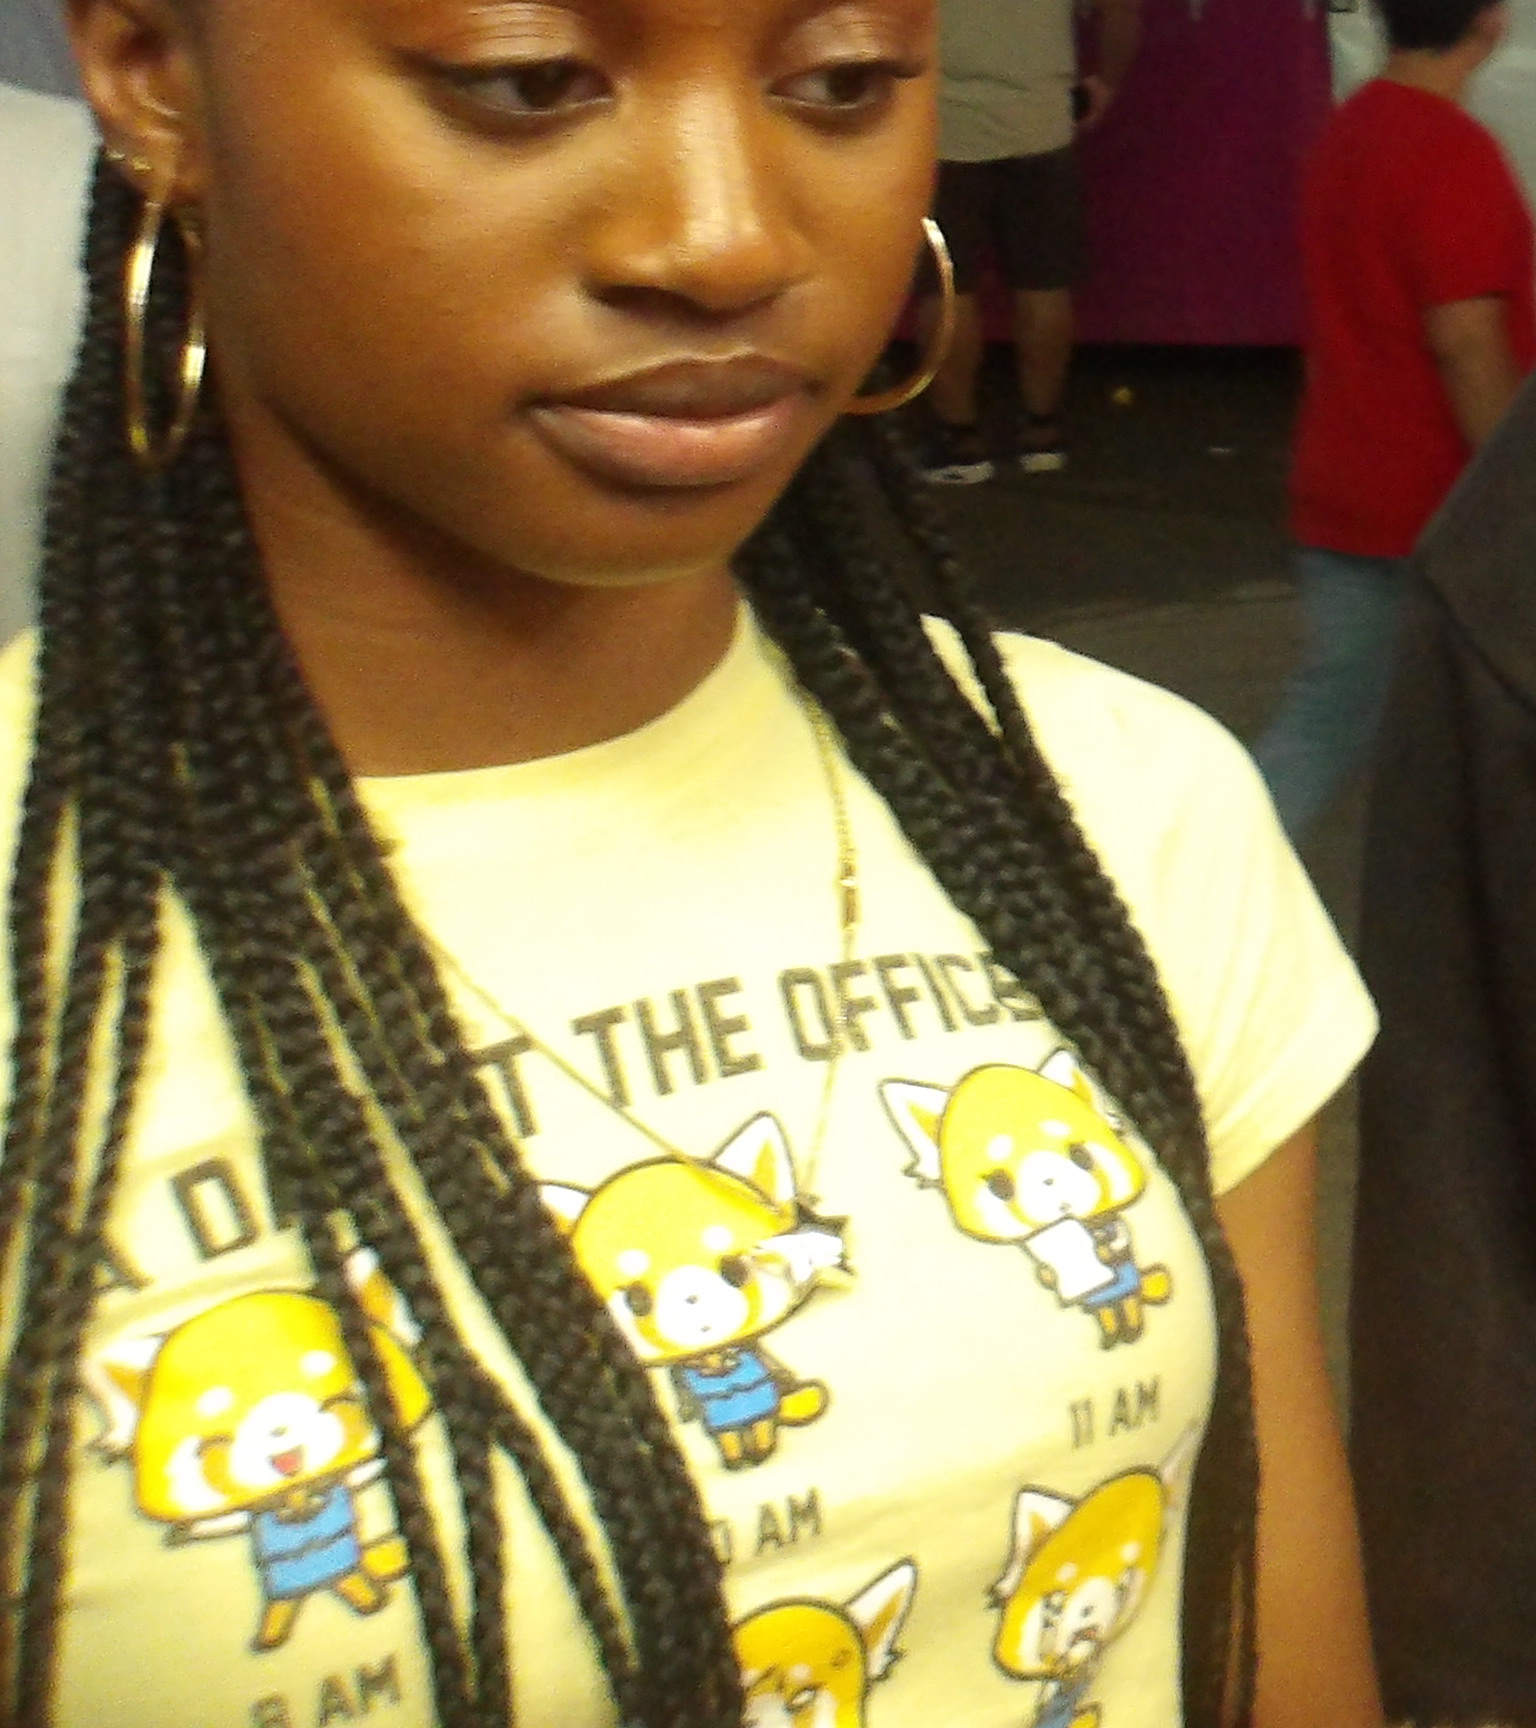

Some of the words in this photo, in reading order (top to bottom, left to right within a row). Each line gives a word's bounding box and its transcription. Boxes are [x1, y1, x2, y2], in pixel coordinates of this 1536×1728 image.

[571, 977, 764, 1108] THE
[777, 951, 1046, 1063] OFFICE
[1107, 1374, 1161, 1437] AM
[756, 1486, 822, 1556] AM
[318, 1651, 401, 1727] AM
